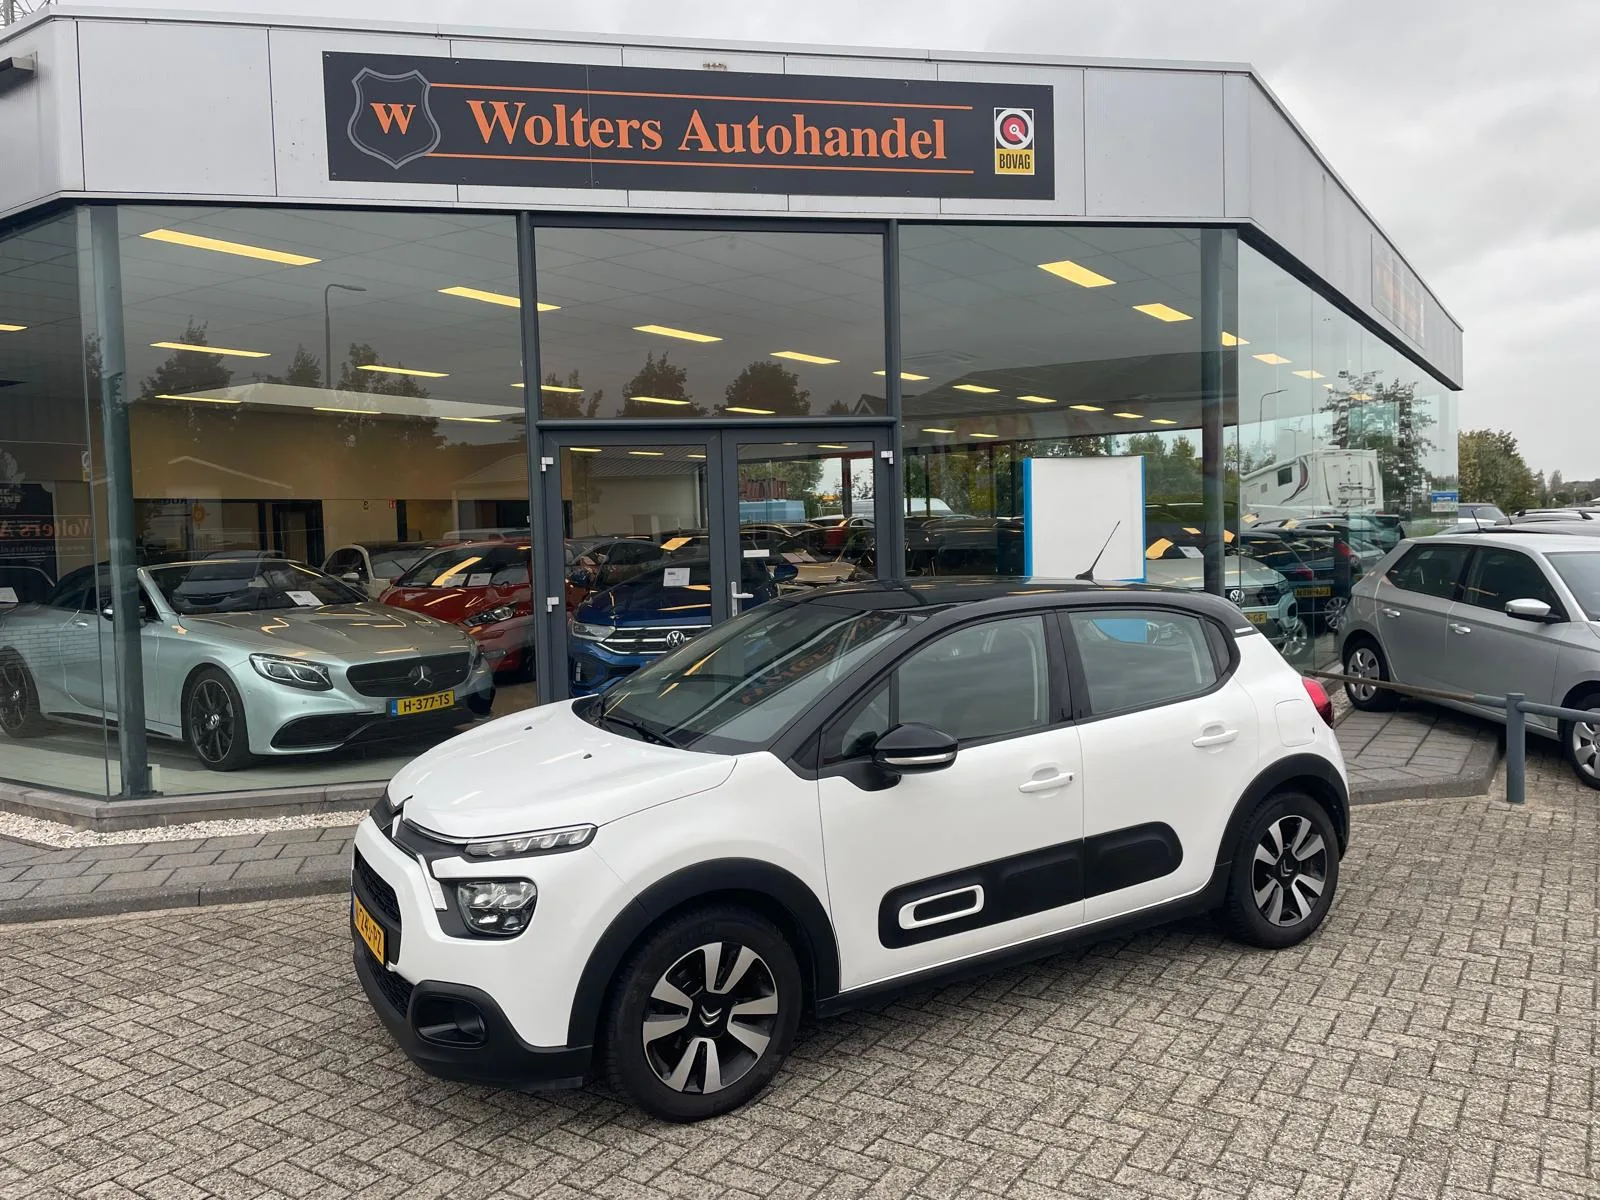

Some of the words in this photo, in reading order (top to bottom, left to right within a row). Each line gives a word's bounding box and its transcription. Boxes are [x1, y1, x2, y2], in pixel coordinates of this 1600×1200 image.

[370, 102, 416, 135] W
[466, 100, 663, 150] Wolters
[678, 109, 948, 160] Autohandel
[999, 153, 1031, 169] BOVAG
[403, 693, 450, 712] H-377-TS
